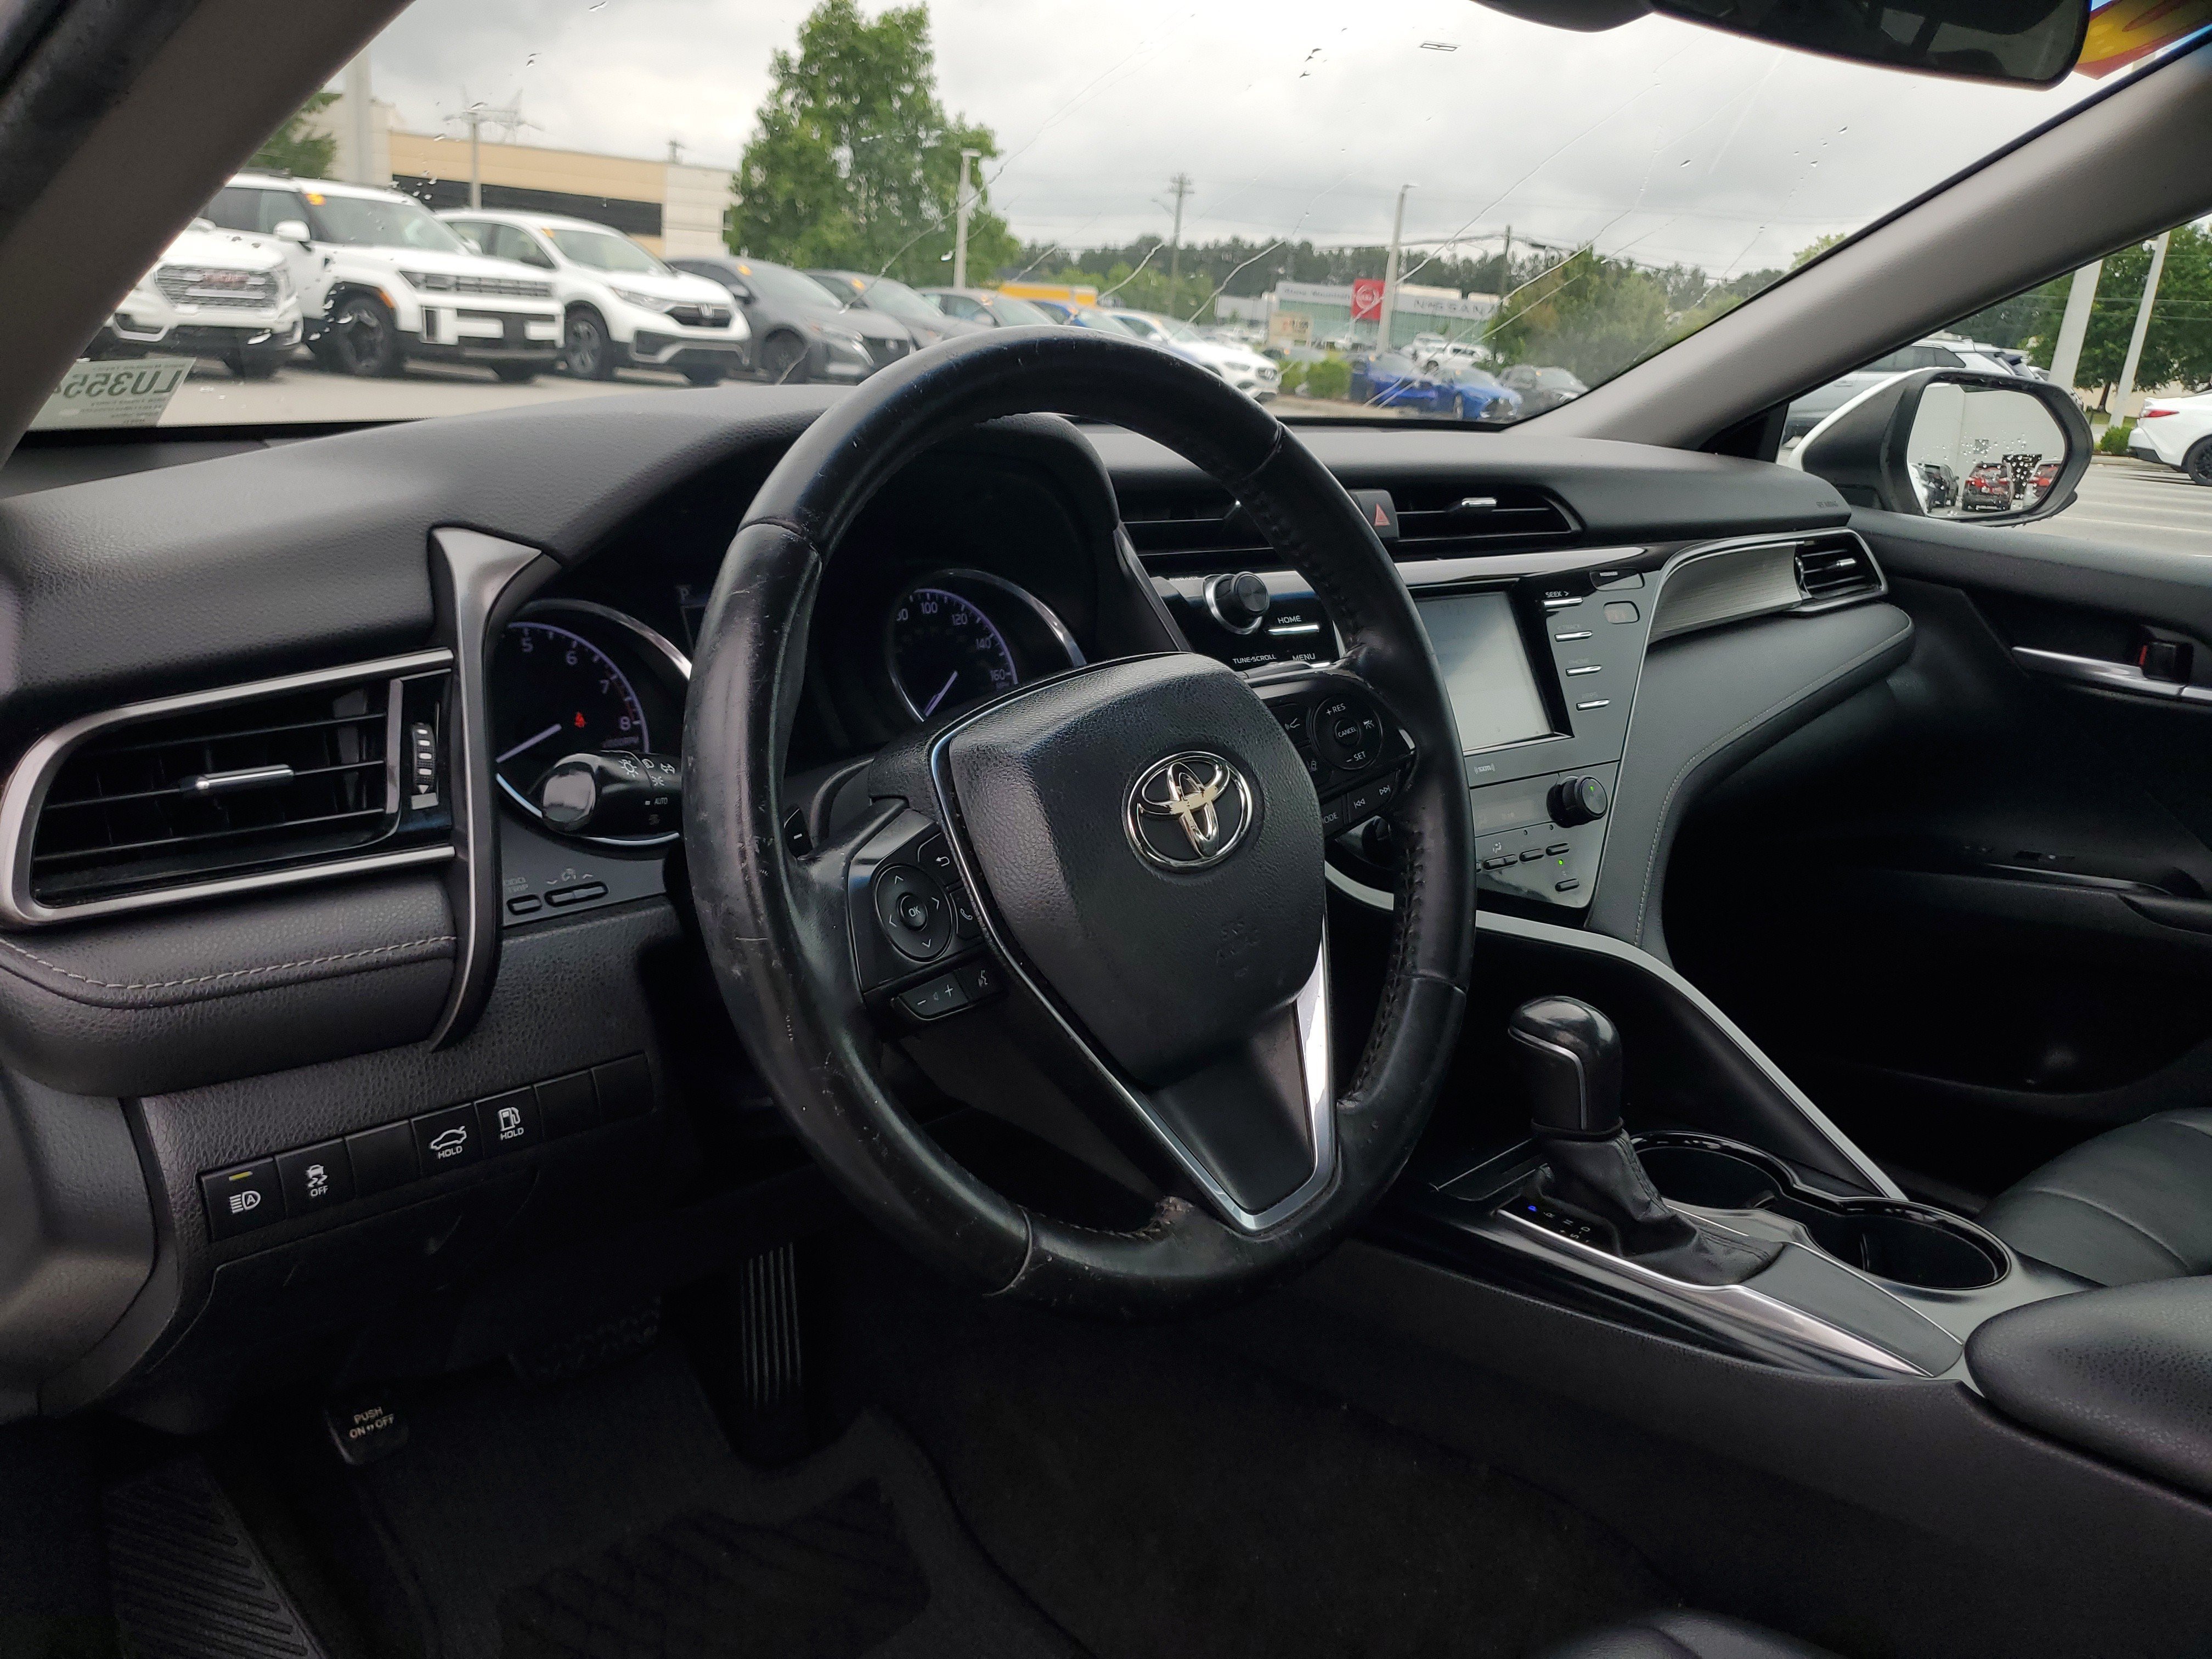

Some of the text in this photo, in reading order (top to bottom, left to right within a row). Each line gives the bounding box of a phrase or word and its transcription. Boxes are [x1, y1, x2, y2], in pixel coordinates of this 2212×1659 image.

[921, 601, 938, 614] 100
[951, 613, 968, 626] 120
[1277, 615, 1302, 624] HOME
[521, 637, 534, 653] 5
[975, 639, 992, 651] 140
[566, 650, 578, 665] 6
[1292, 653, 1316, 662] MENU
[990, 669, 1006, 681] 160
[600, 679, 610, 694] 7
[619, 715, 631, 731] 8
[1338, 726, 1357, 738] CANCEL
[1322, 812, 1339, 824] ODE
[909, 906, 921, 917] OK
[500, 1127, 524, 1141] HOLD
[438, 1146, 463, 1159] HOLD
[310, 1185, 329, 1198] OFF
[247, 1194, 256, 1205] A
[354, 1406, 383, 1425] PUSH
